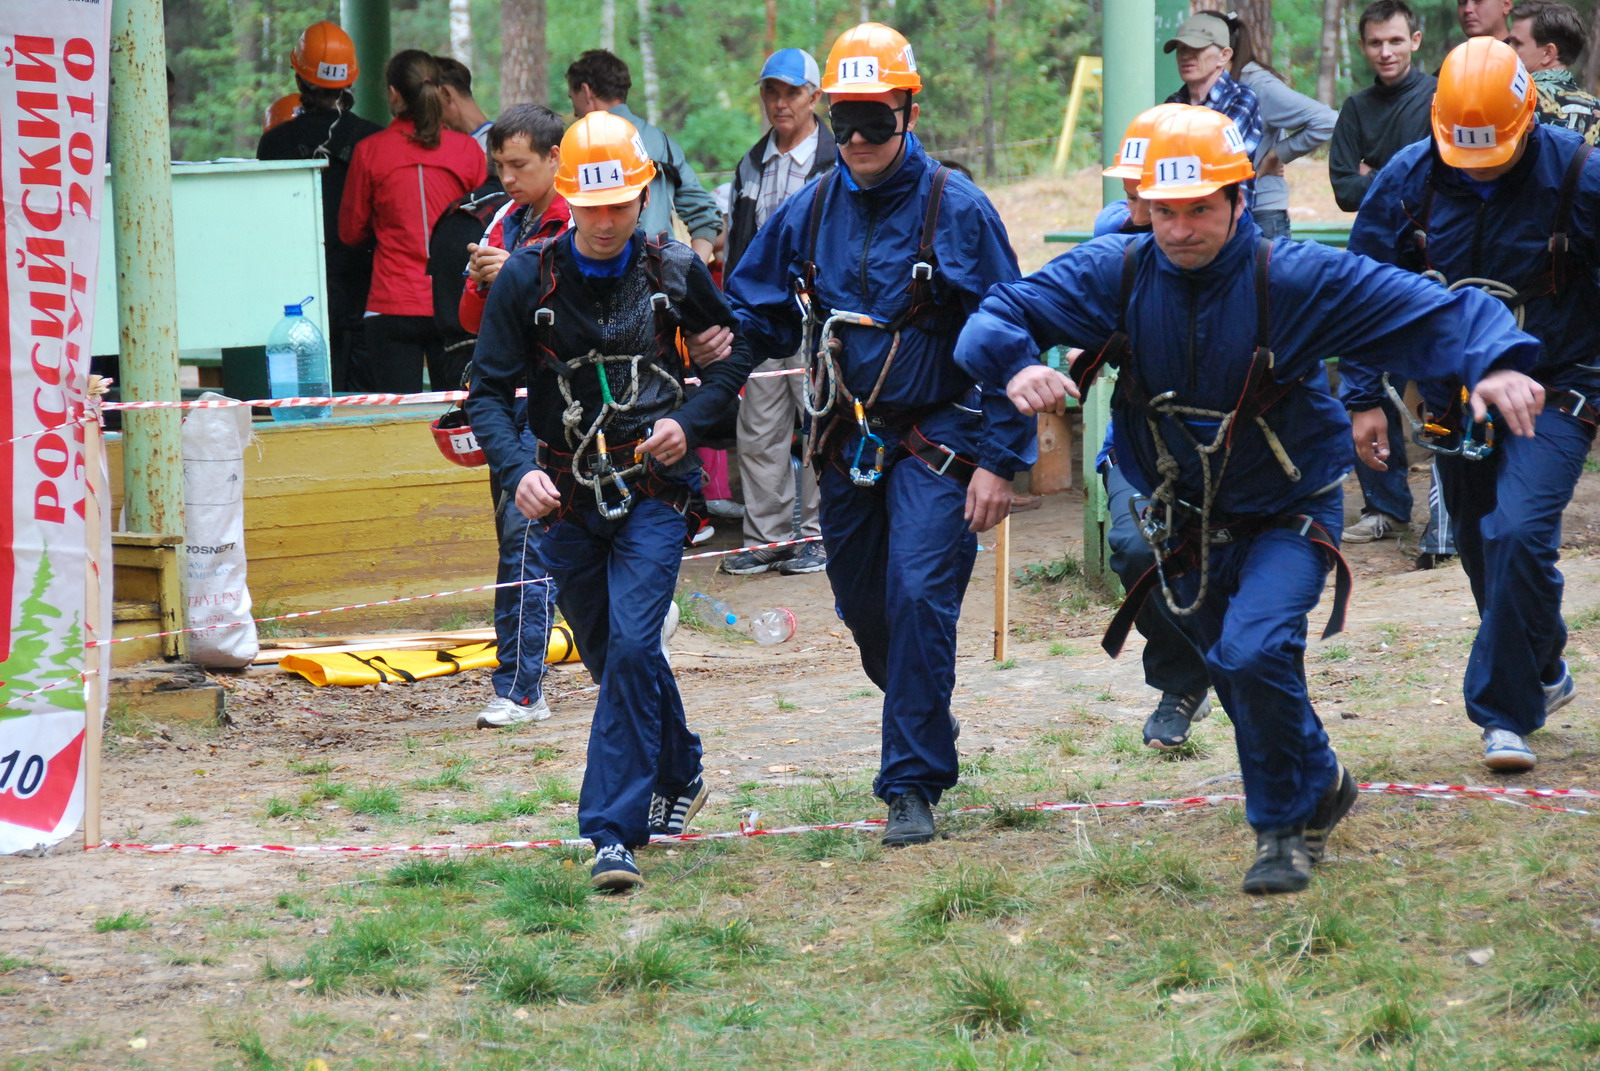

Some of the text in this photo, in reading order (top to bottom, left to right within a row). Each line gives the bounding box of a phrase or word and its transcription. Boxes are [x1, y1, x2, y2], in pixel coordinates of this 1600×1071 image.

[63, 37, 95, 222] 2010
[1125, 141, 1142, 159] 11
[5, 34, 69, 524] РОССИЙСКИЙ
[0, 749, 45, 795] 10
